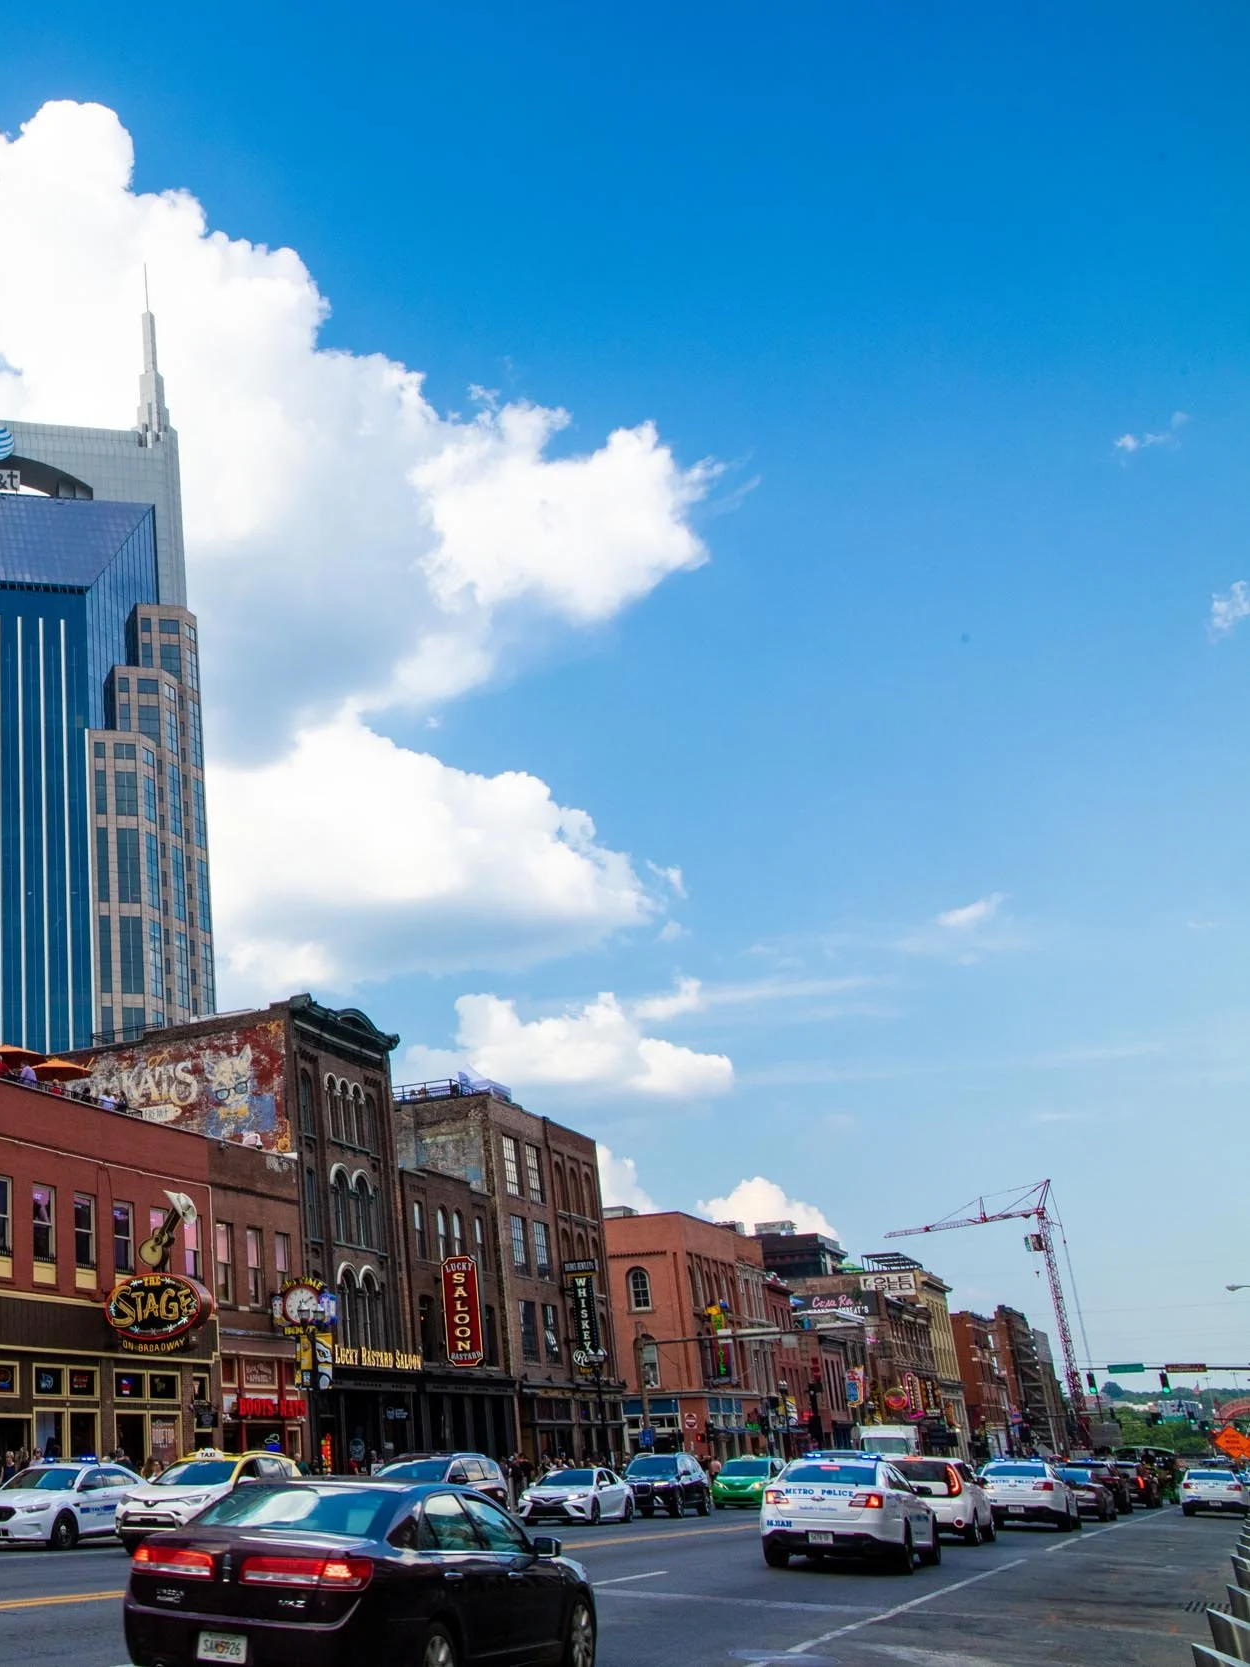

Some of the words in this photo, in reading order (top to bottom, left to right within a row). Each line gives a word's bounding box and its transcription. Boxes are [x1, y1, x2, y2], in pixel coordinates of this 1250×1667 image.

[445, 1262, 474, 1273] LUCKY
[143, 1275, 161, 1287] THE
[874, 1275, 910, 1284] OLE
[111, 1285, 197, 1328] STAGE
[453, 1272, 471, 1352] SALOON
[574, 1278, 591, 1352] WHISKEY
[122, 1339, 134, 1351] ON
[138, 1337, 186, 1353] BROADWAY
[334, 1344, 359, 1366] LUCKY
[361, 1346, 393, 1368] BASTARD
[395, 1350, 422, 1371] SALOON
[450, 1351, 484, 1362] BASTARD
[239, 1398, 274, 1417] BOOTS
[280, 1399, 307, 1417] HATS
[785, 1488, 815, 1496] METRO
[821, 1489, 855, 1498] POLICE
